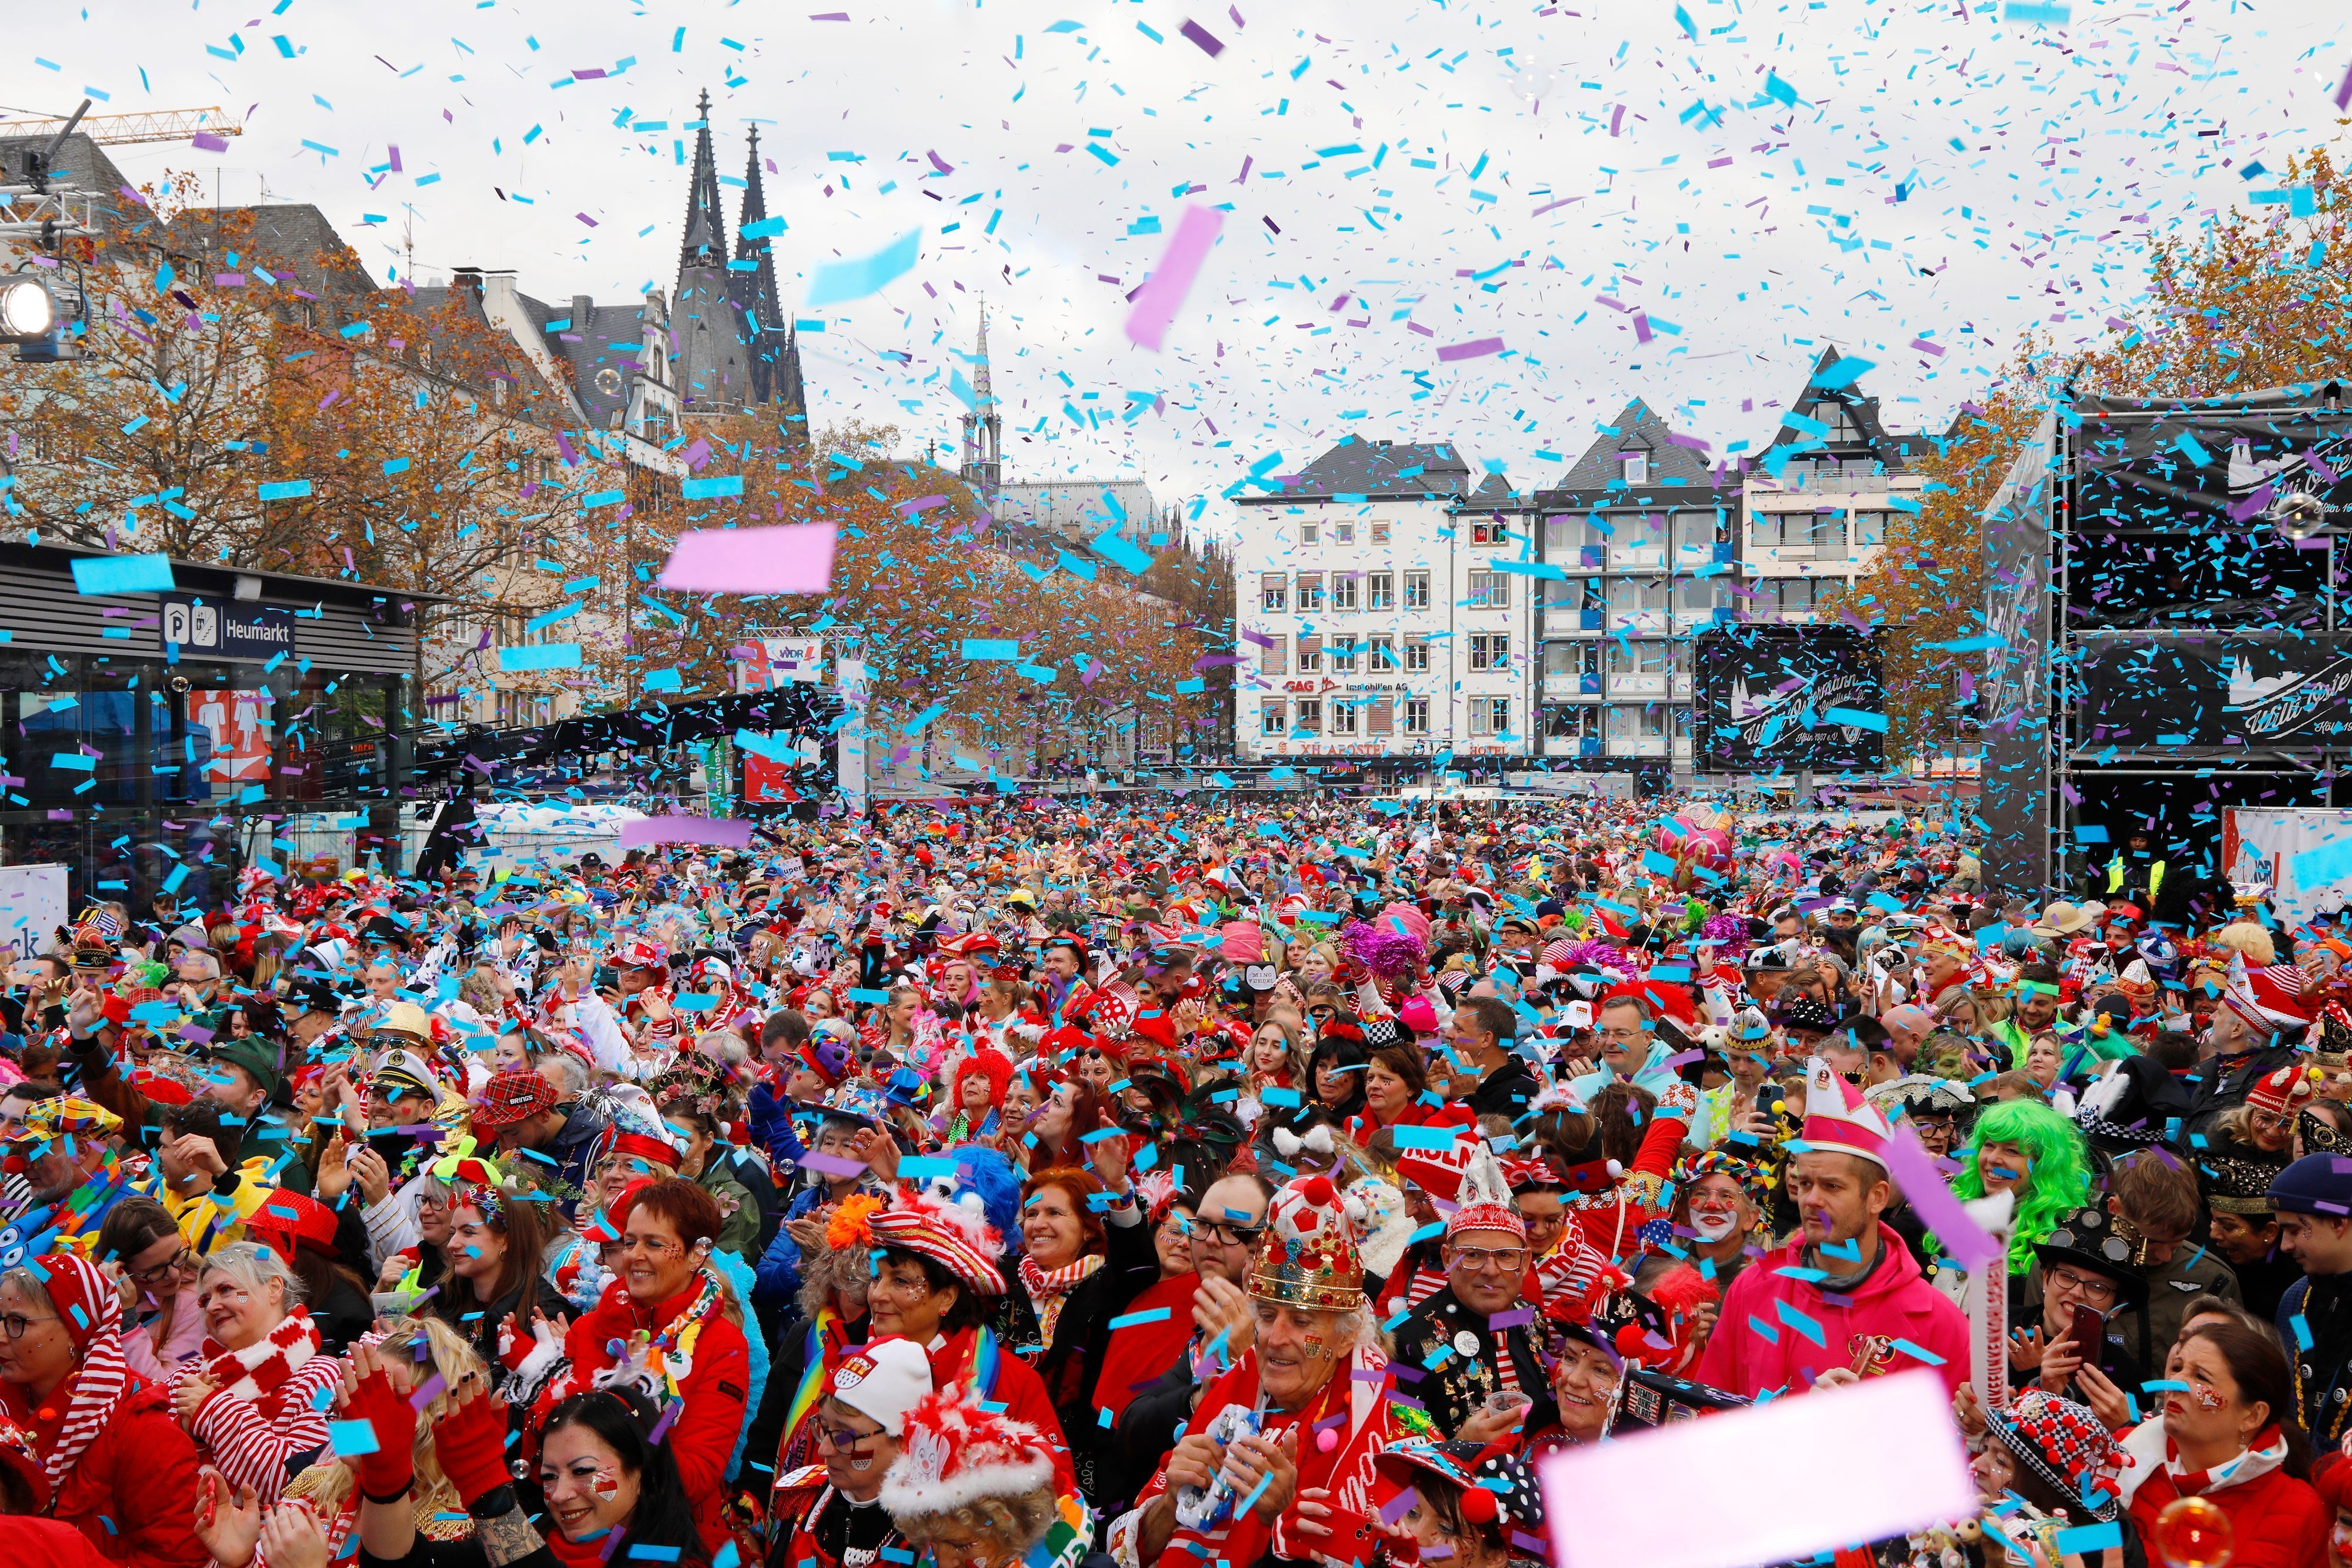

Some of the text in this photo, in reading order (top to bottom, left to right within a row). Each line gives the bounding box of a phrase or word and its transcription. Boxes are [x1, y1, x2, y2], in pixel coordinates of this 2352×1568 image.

[226, 619, 289, 642] Heumarkt
[1285, 680, 1314, 692] GAG
[1395, 683, 1408, 691] AG
[1470, 745, 1509, 755] HOTEL
[509, 1095, 533, 1105] BRINGS
[1638, 1398, 1651, 1411] OHNE
[1635, 1405, 1652, 1420] ALAAF
